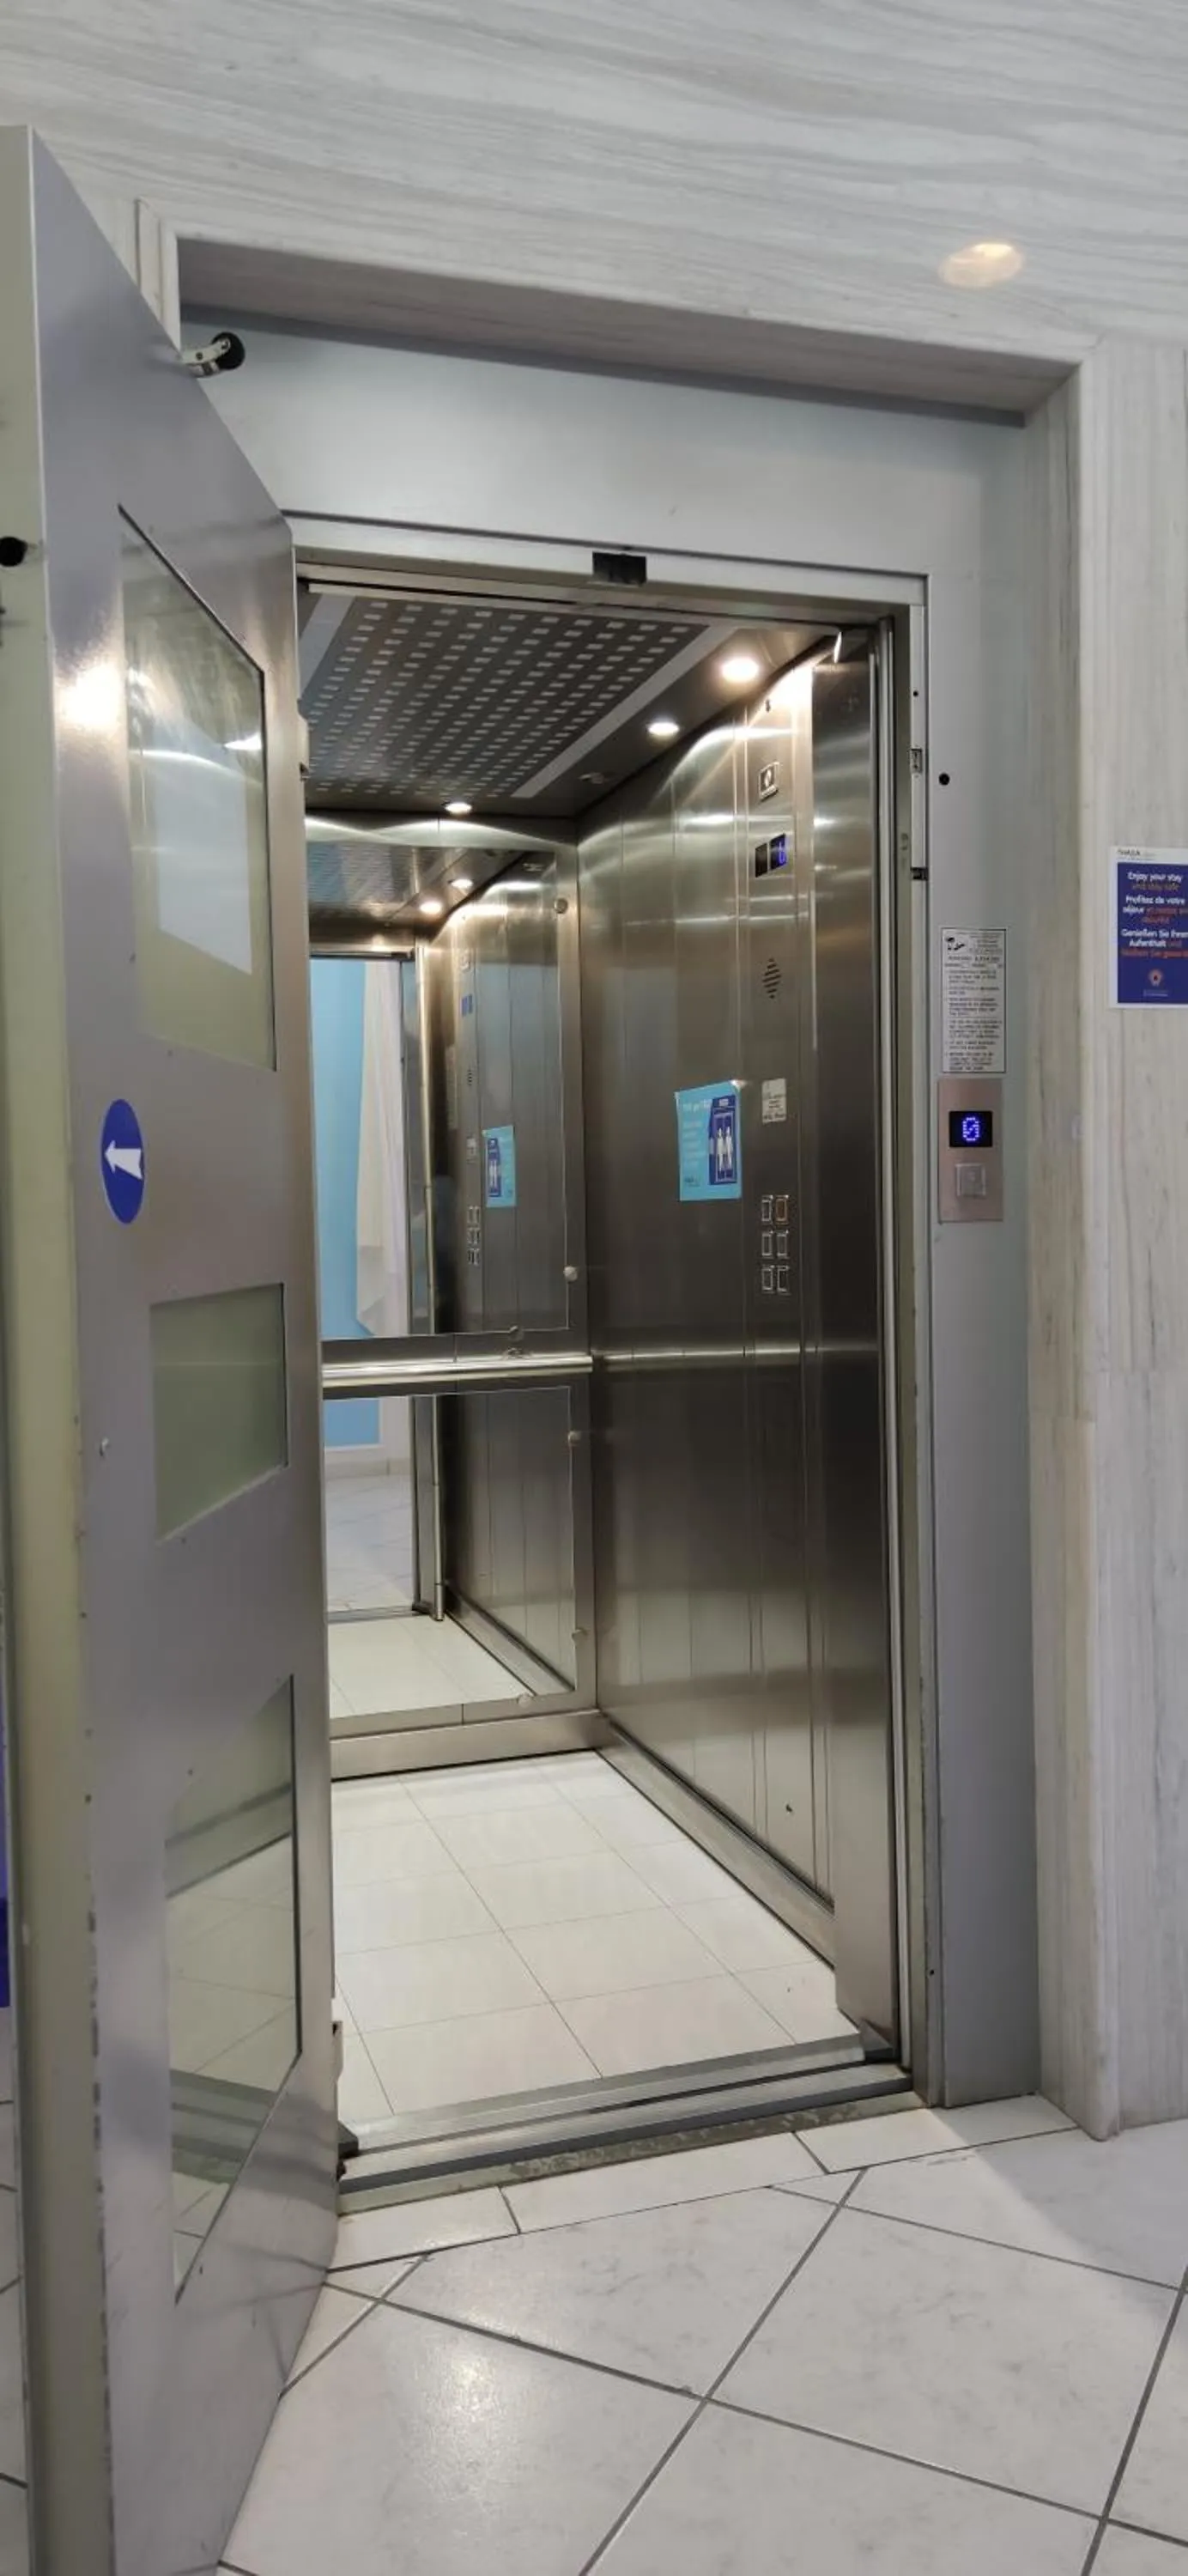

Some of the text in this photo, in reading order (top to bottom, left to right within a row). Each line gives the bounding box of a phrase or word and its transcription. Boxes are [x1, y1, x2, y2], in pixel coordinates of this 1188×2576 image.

[1127, 872, 1183, 884] Enjoy your stay
[1126, 895, 1185, 906] Profitez de votre
[962, 1117, 979, 1141] 0
